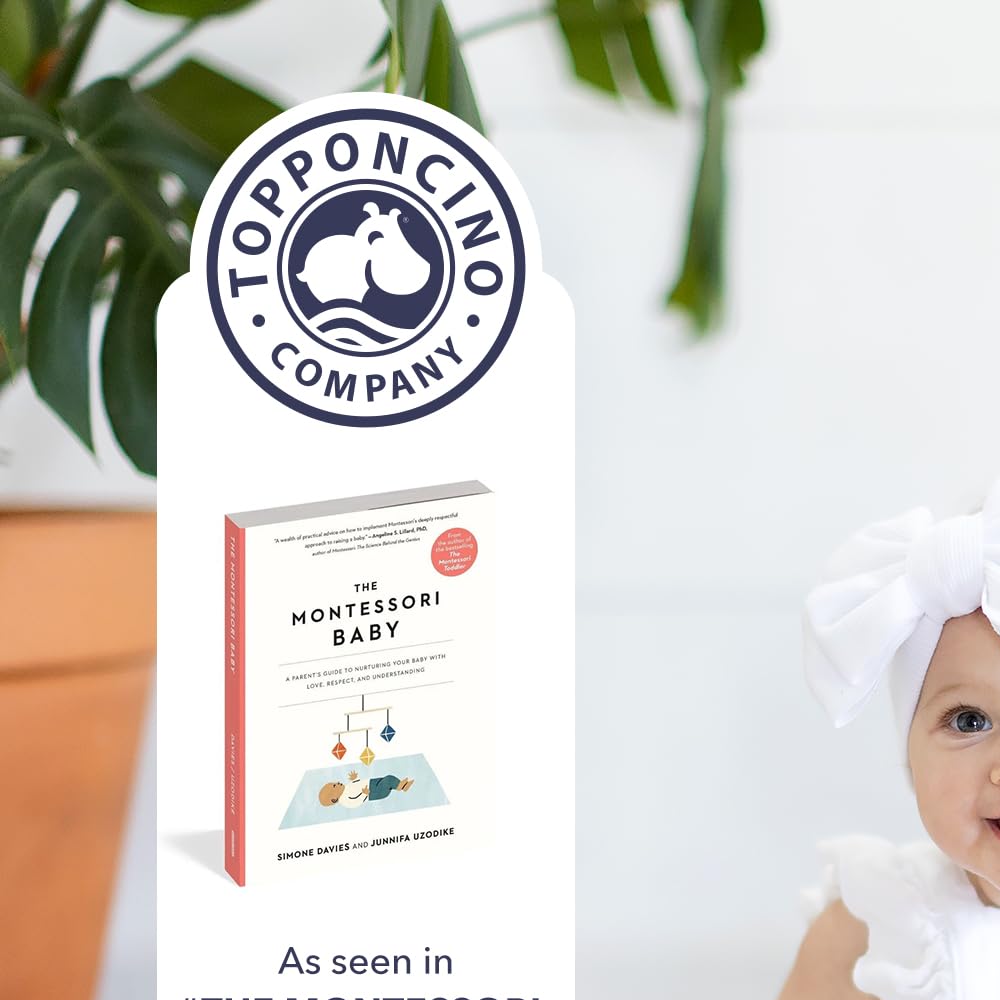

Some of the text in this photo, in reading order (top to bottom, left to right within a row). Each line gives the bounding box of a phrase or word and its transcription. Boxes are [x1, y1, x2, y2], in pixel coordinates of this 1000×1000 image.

[354, 582, 377, 592] THE
[292, 591, 440, 626] MONTESSORI
[333, 620, 400, 647] BABY
[291, 671, 322, 681] PARENT'S
[322, 668, 343, 676] GUIDE
[354, 661, 391, 672] NURTURING
[392, 658, 410, 666] YOUR
[411, 655, 428, 664] BABY
[429, 653, 447, 661] WITH
[356, 674, 371, 682] AND
[372, 666, 426, 680] UNDERSTANDING
[278, 849, 313, 861] SIMONE
[317, 843, 349, 855] DAVIES
[371, 835, 410, 846] JUNNIFA
[414, 828, 454, 840] UZODIKE
